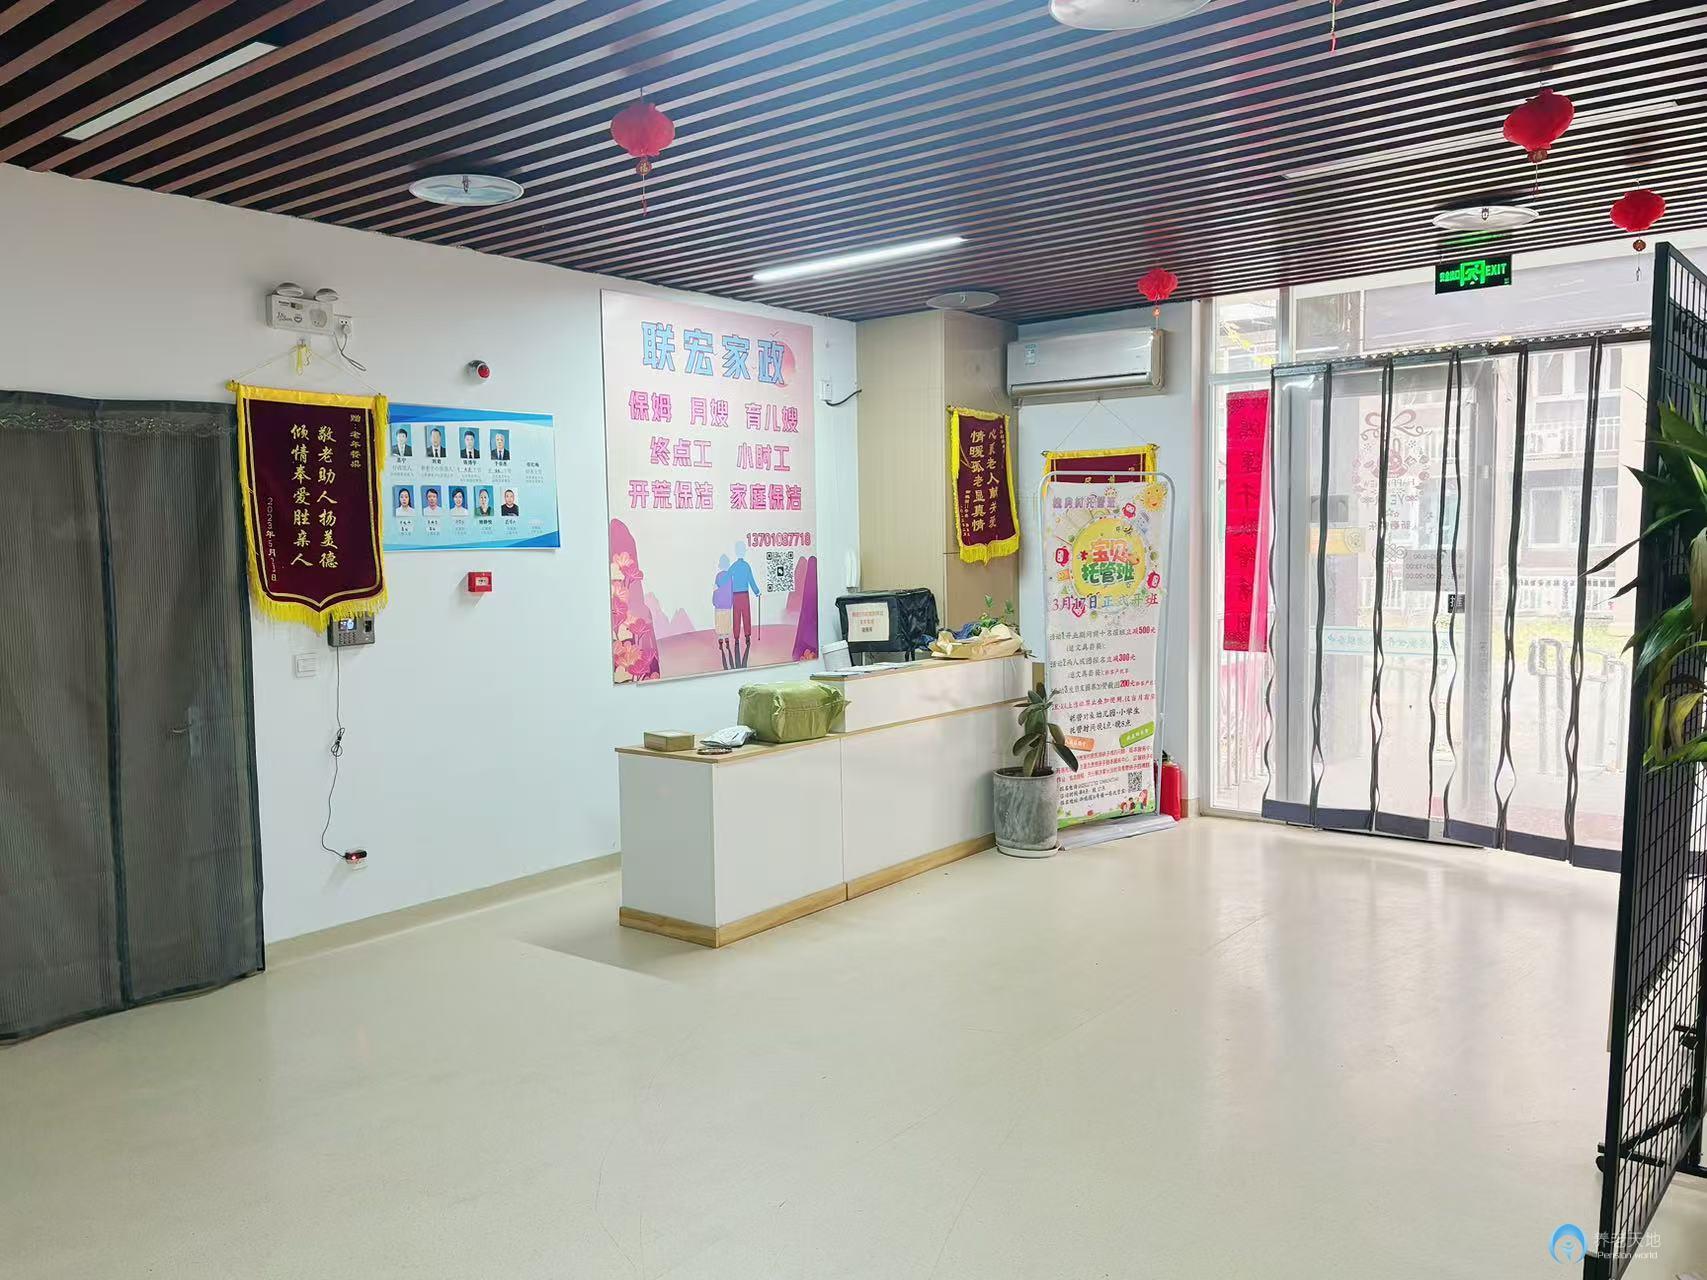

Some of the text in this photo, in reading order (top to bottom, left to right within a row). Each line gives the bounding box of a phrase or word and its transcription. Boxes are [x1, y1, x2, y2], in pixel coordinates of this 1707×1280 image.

[1485, 263, 1507, 276] EXIT
[640, 319, 786, 386] 联宏家政
[628, 390, 800, 434] 保姆 月嫂 育儿嫂
[649, 436, 791, 472] 终点工 小时工
[290, 424, 313, 566] 倾情奉爱胜亲人
[316, 426, 338, 569] 敬老助人扬美德
[628, 479, 802, 512] 开荒保洁 家庭保洁
[1081, 561, 1135, 584] 托管班
